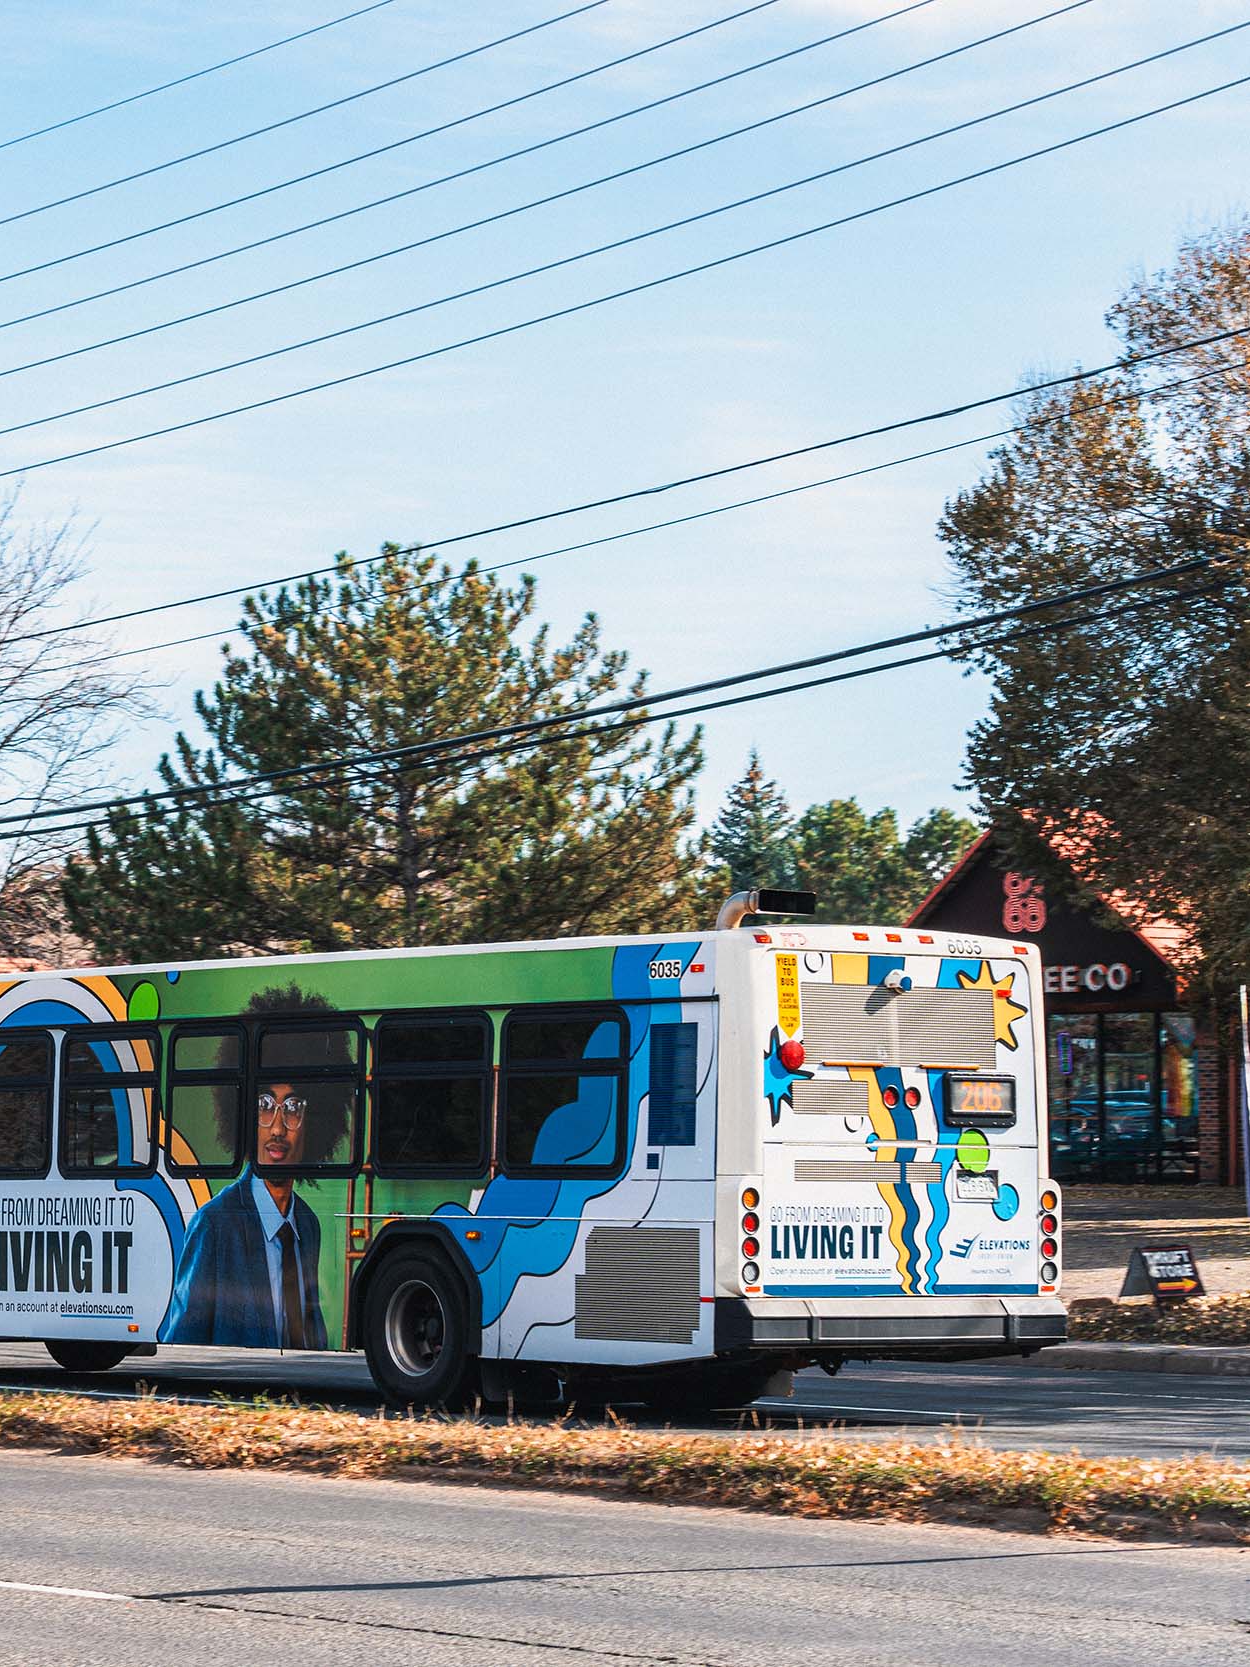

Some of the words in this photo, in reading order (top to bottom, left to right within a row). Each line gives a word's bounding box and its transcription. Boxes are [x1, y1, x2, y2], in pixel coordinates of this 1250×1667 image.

[947, 939, 982, 955] 6035
[650, 961, 680, 978] 6035
[776, 957, 797, 966] YIELD
[782, 967, 792, 976] TO
[1085, 963, 1130, 991] CO
[780, 977, 795, 986] BUS
[960, 1081, 1003, 1111] 206
[1, 1198, 34, 1226] FROM
[38, 1197, 100, 1226] DREAMING
[104, 1197, 116, 1226] IT
[119, 1197, 134, 1226] TO
[770, 1206, 782, 1222] GO
[785, 1206, 811, 1222] FROM
[813, 1206, 860, 1222] DREAMING
[863, 1206, 871, 1222] IT
[873, 1206, 884, 1222] TO
[771, 1225, 854, 1260] LIVING
[862, 1225, 883, 1259] IT
[979, 1240, 1030, 1250] ELEVATIONS
[102, 1231, 133, 1293] IT
[1149, 1264, 1195, 1278] STORE
[5, 1302, 16, 1312] an
[16, 1301, 48, 1313] account
[50, 1302, 59, 1313] at
[60, 1300, 134, 1315] elevationscu.com
